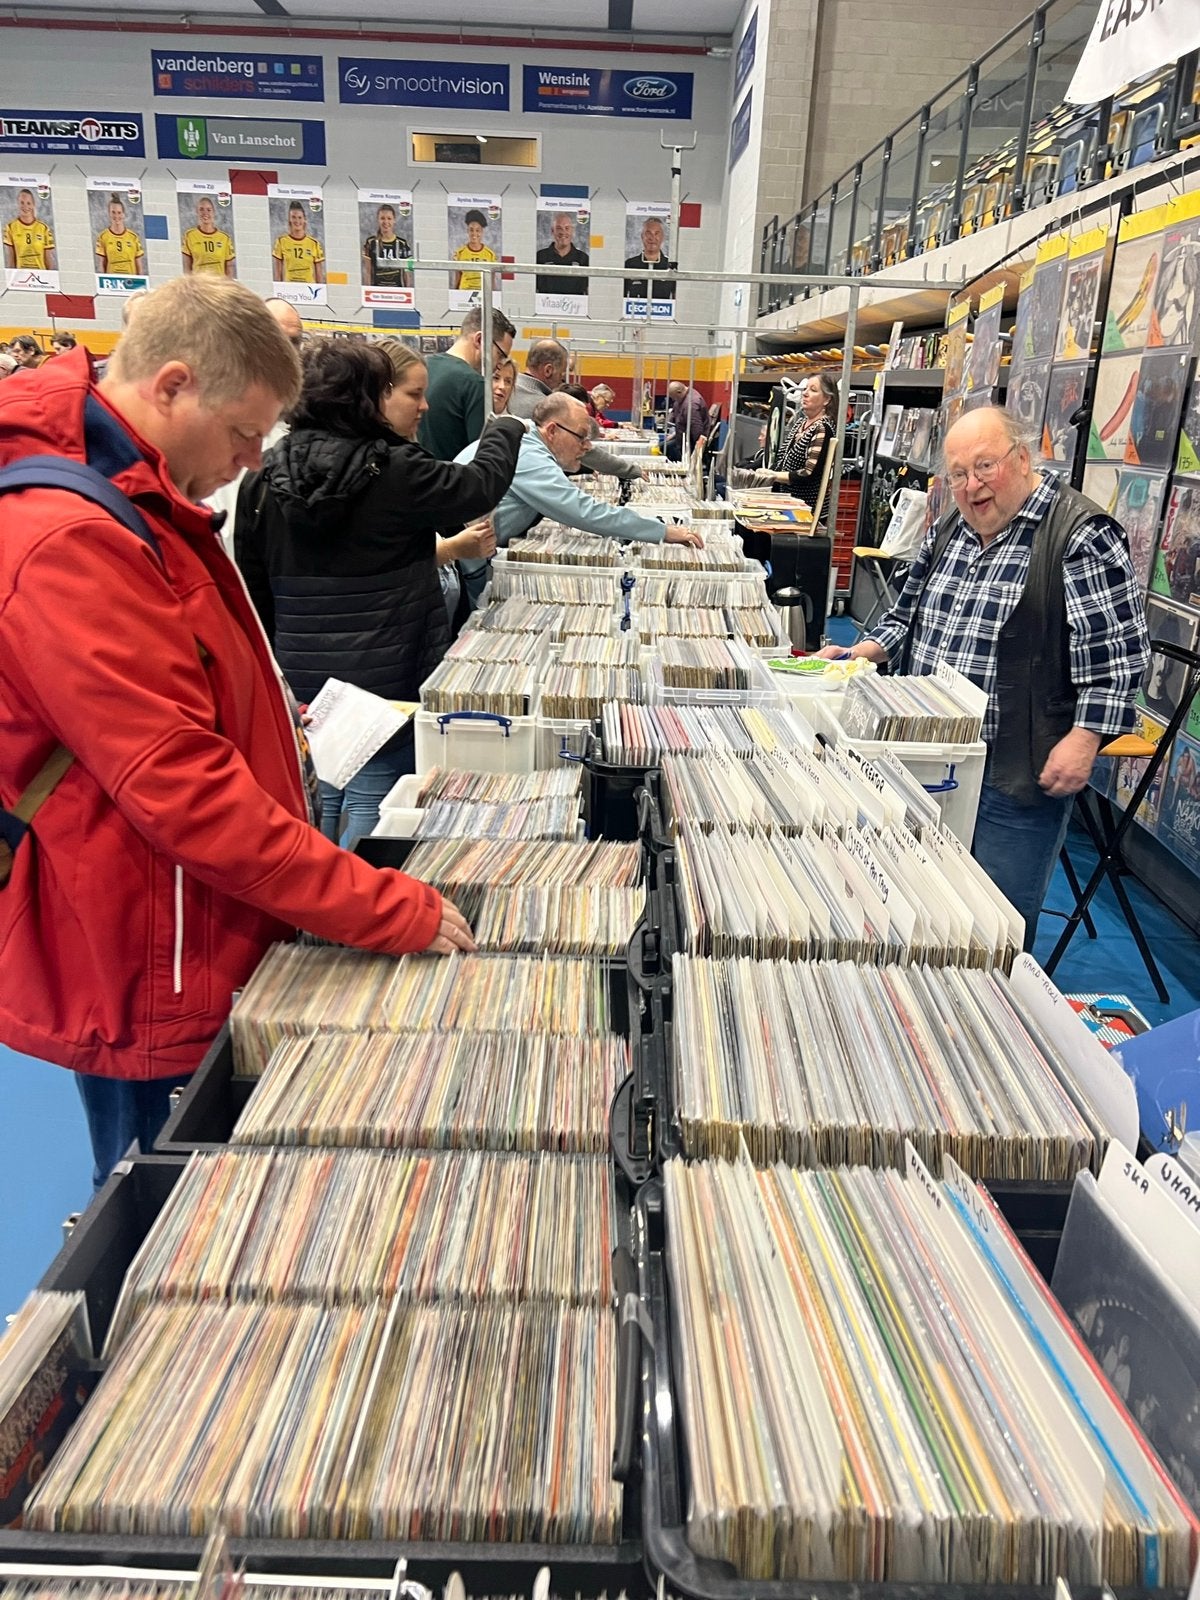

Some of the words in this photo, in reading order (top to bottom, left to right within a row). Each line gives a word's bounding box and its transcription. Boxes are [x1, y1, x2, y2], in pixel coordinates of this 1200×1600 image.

[156, 56, 254, 78] vandenberg
[183, 75, 255, 93] schilders
[374, 75, 505, 95] smoothvision
[538, 71, 591, 86] Wensink
[631, 78, 666, 97] Ford
[211, 132, 237, 145] Van
[238, 133, 297, 148] Lanschot
[25, 233, 31, 246] 8
[116, 241, 122, 253] 9
[203, 240, 215, 253] 10
[293, 247, 304, 260] 12
[383, 248, 393, 260] 14
[299, 293, 312, 302] You
[1123, 1162, 1150, 1195] SKA
[1161, 1162, 1200, 1213] WHAM
